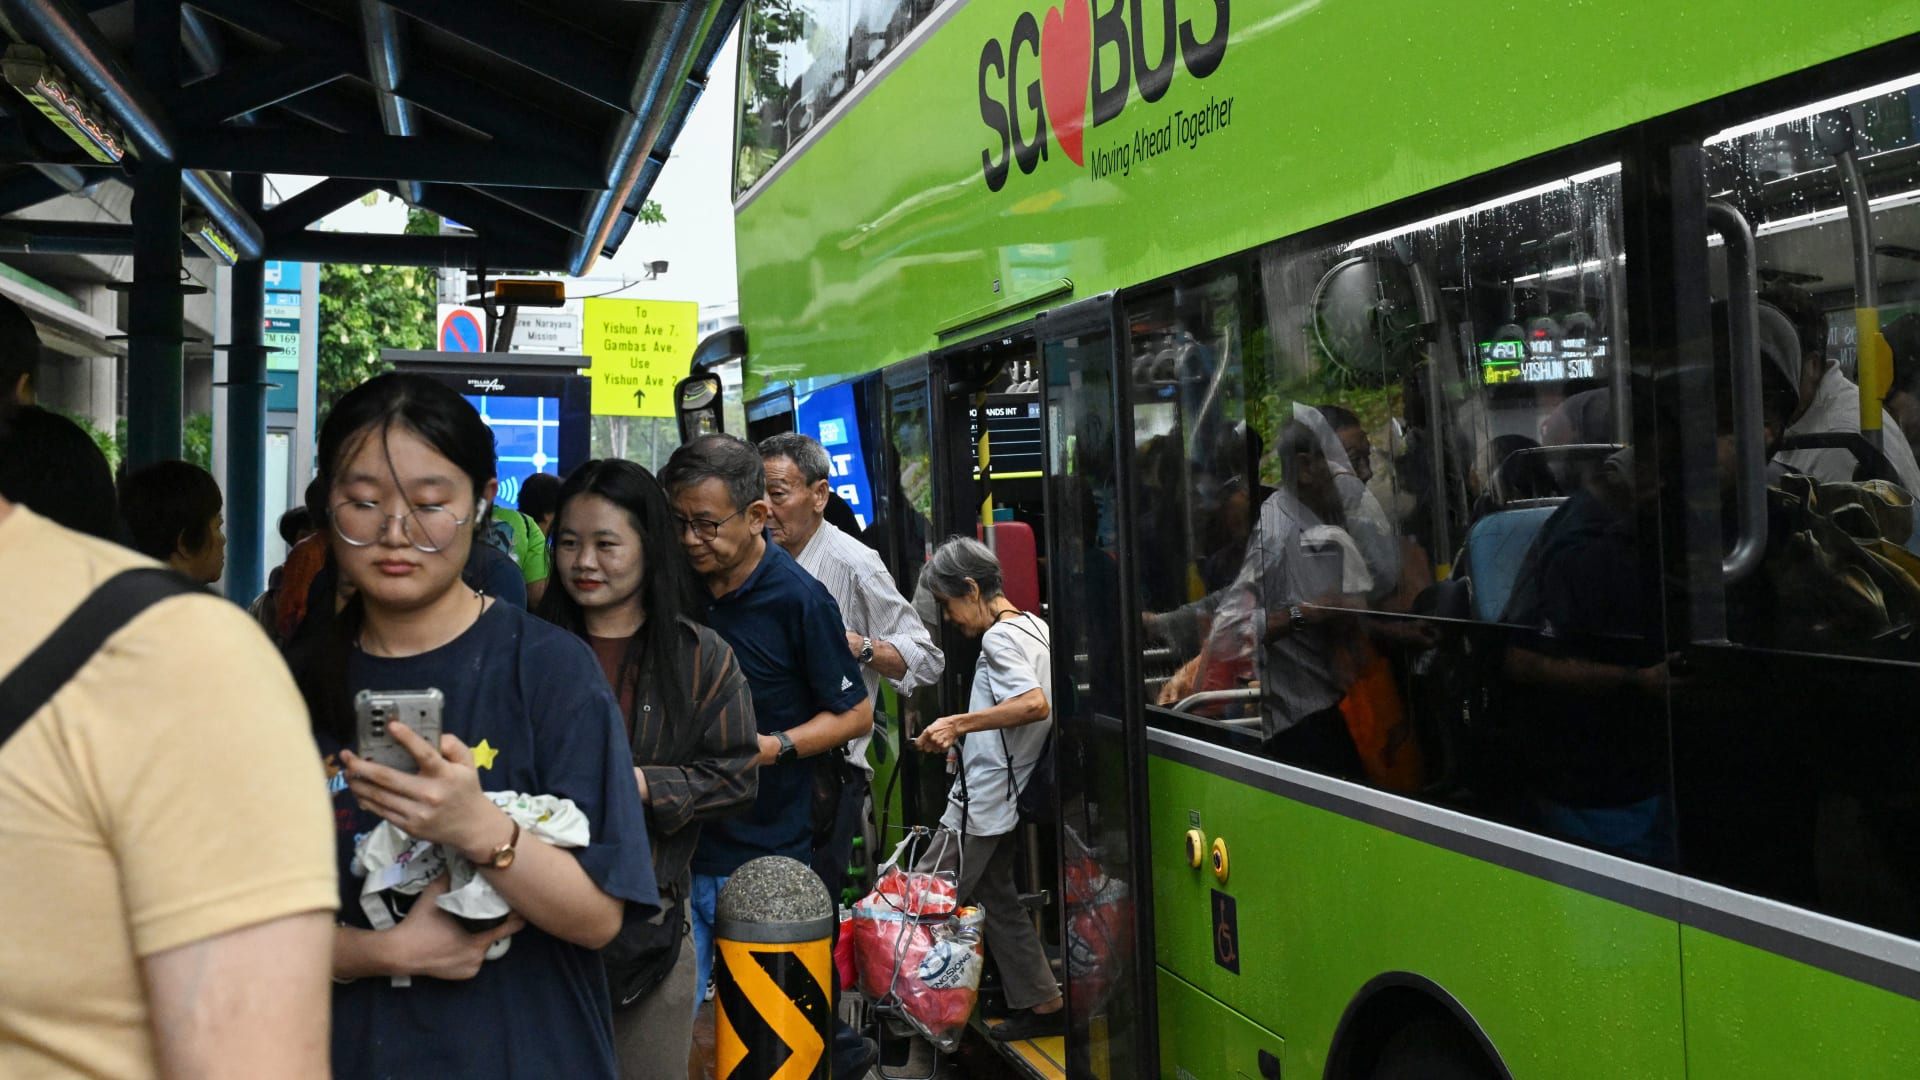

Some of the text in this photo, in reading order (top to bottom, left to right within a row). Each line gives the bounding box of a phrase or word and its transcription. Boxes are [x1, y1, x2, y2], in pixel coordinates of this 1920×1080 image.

[978, 11, 1049, 193] SG
[1091, 95, 1234, 183] Moving Ahead Together
[636, 306, 648, 318] To
[535, 318, 572, 329] Narayana
[603, 321, 638, 335] Yishun
[644, 324, 663, 336] Ave
[280, 335, 297, 344] 169
[527, 331, 558, 341] Mission
[603, 338, 647, 353] Gambas
[630, 356, 650, 369] Use
[1520, 360, 1565, 382] YISHUN
[1568, 358, 1594, 379] STN
[603, 373, 639, 386] Yishun
[645, 375, 664, 387] Ave
